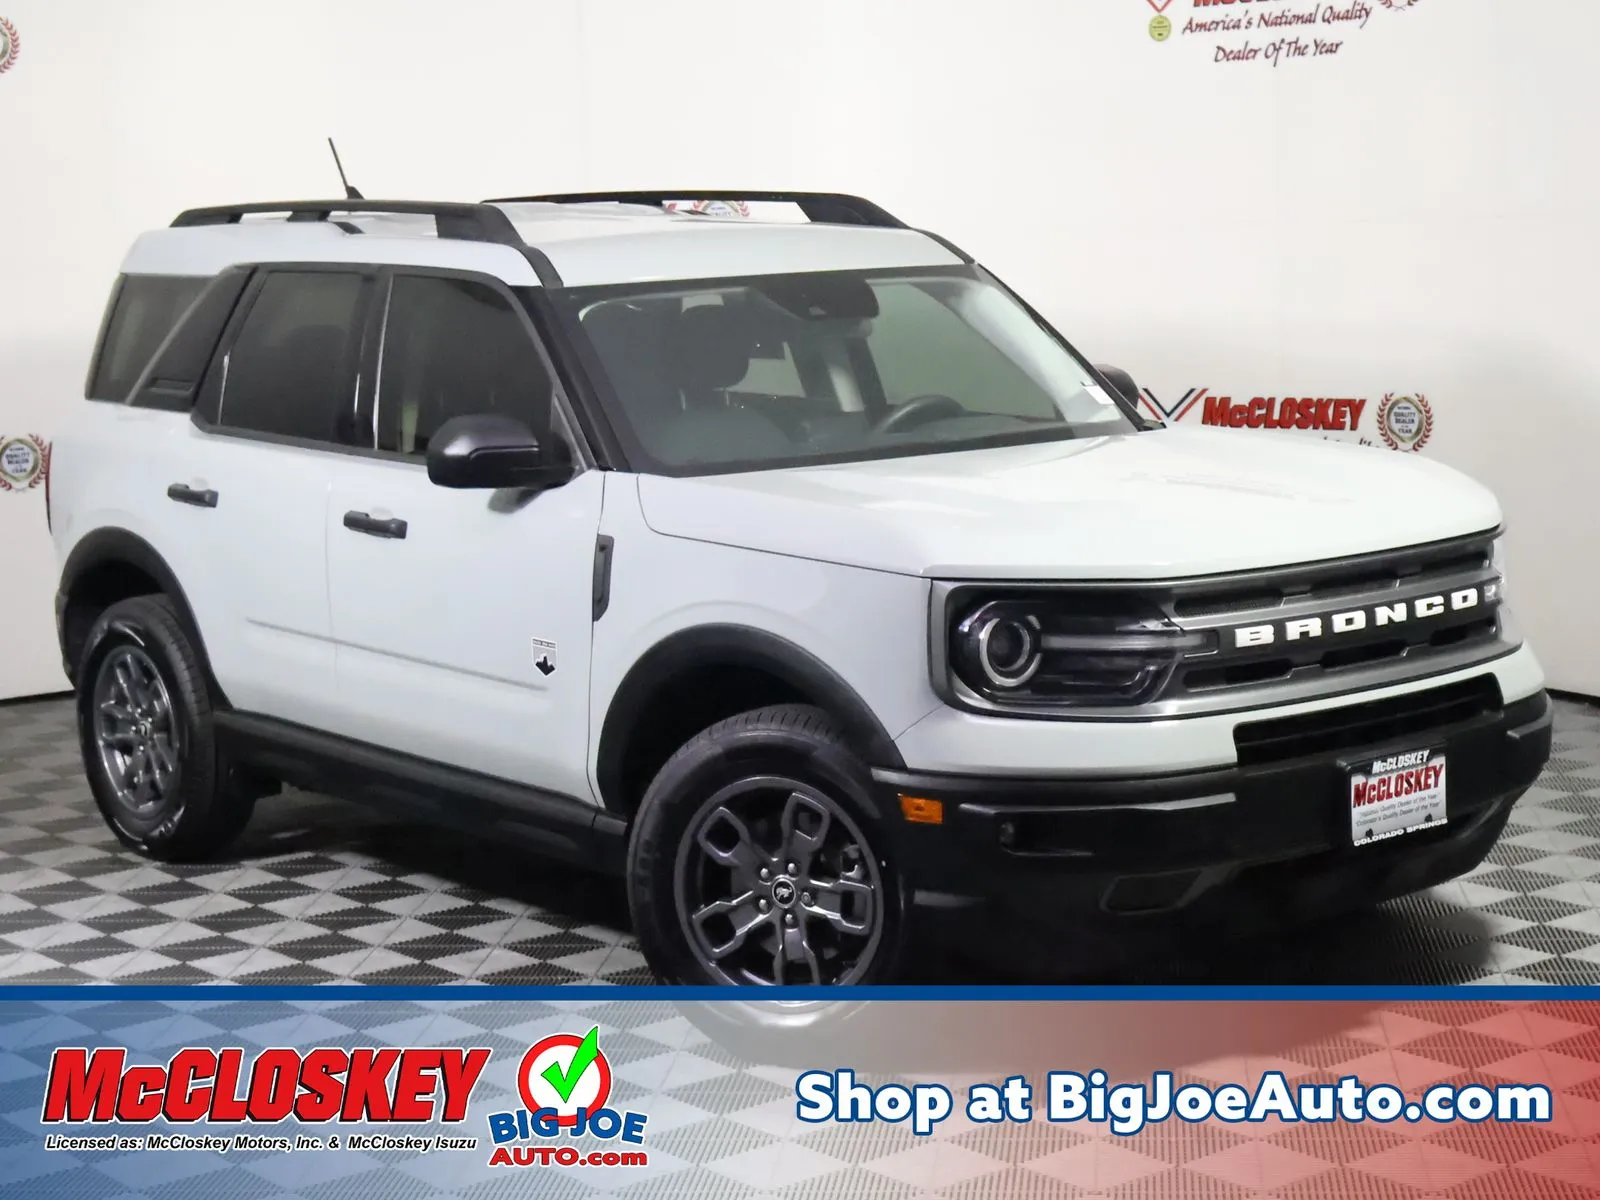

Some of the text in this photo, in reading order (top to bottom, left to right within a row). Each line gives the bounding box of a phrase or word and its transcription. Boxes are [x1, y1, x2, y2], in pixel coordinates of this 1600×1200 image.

[1182, 10, 1252, 34] America's
[1256, 3, 1317, 28] National
[1322, 2, 1372, 28] Quality
[1213, 37, 1343, 67] Dealer Of The Year
[1201, 396, 1366, 430] McCLOSKEY
[1235, 588, 1478, 648] BRONCO
[1372, 749, 1430, 774] McCLOSKEY
[1353, 763, 1444, 808] McCLOSKEY
[1353, 817, 1448, 847] COLORADO SPRINGS
